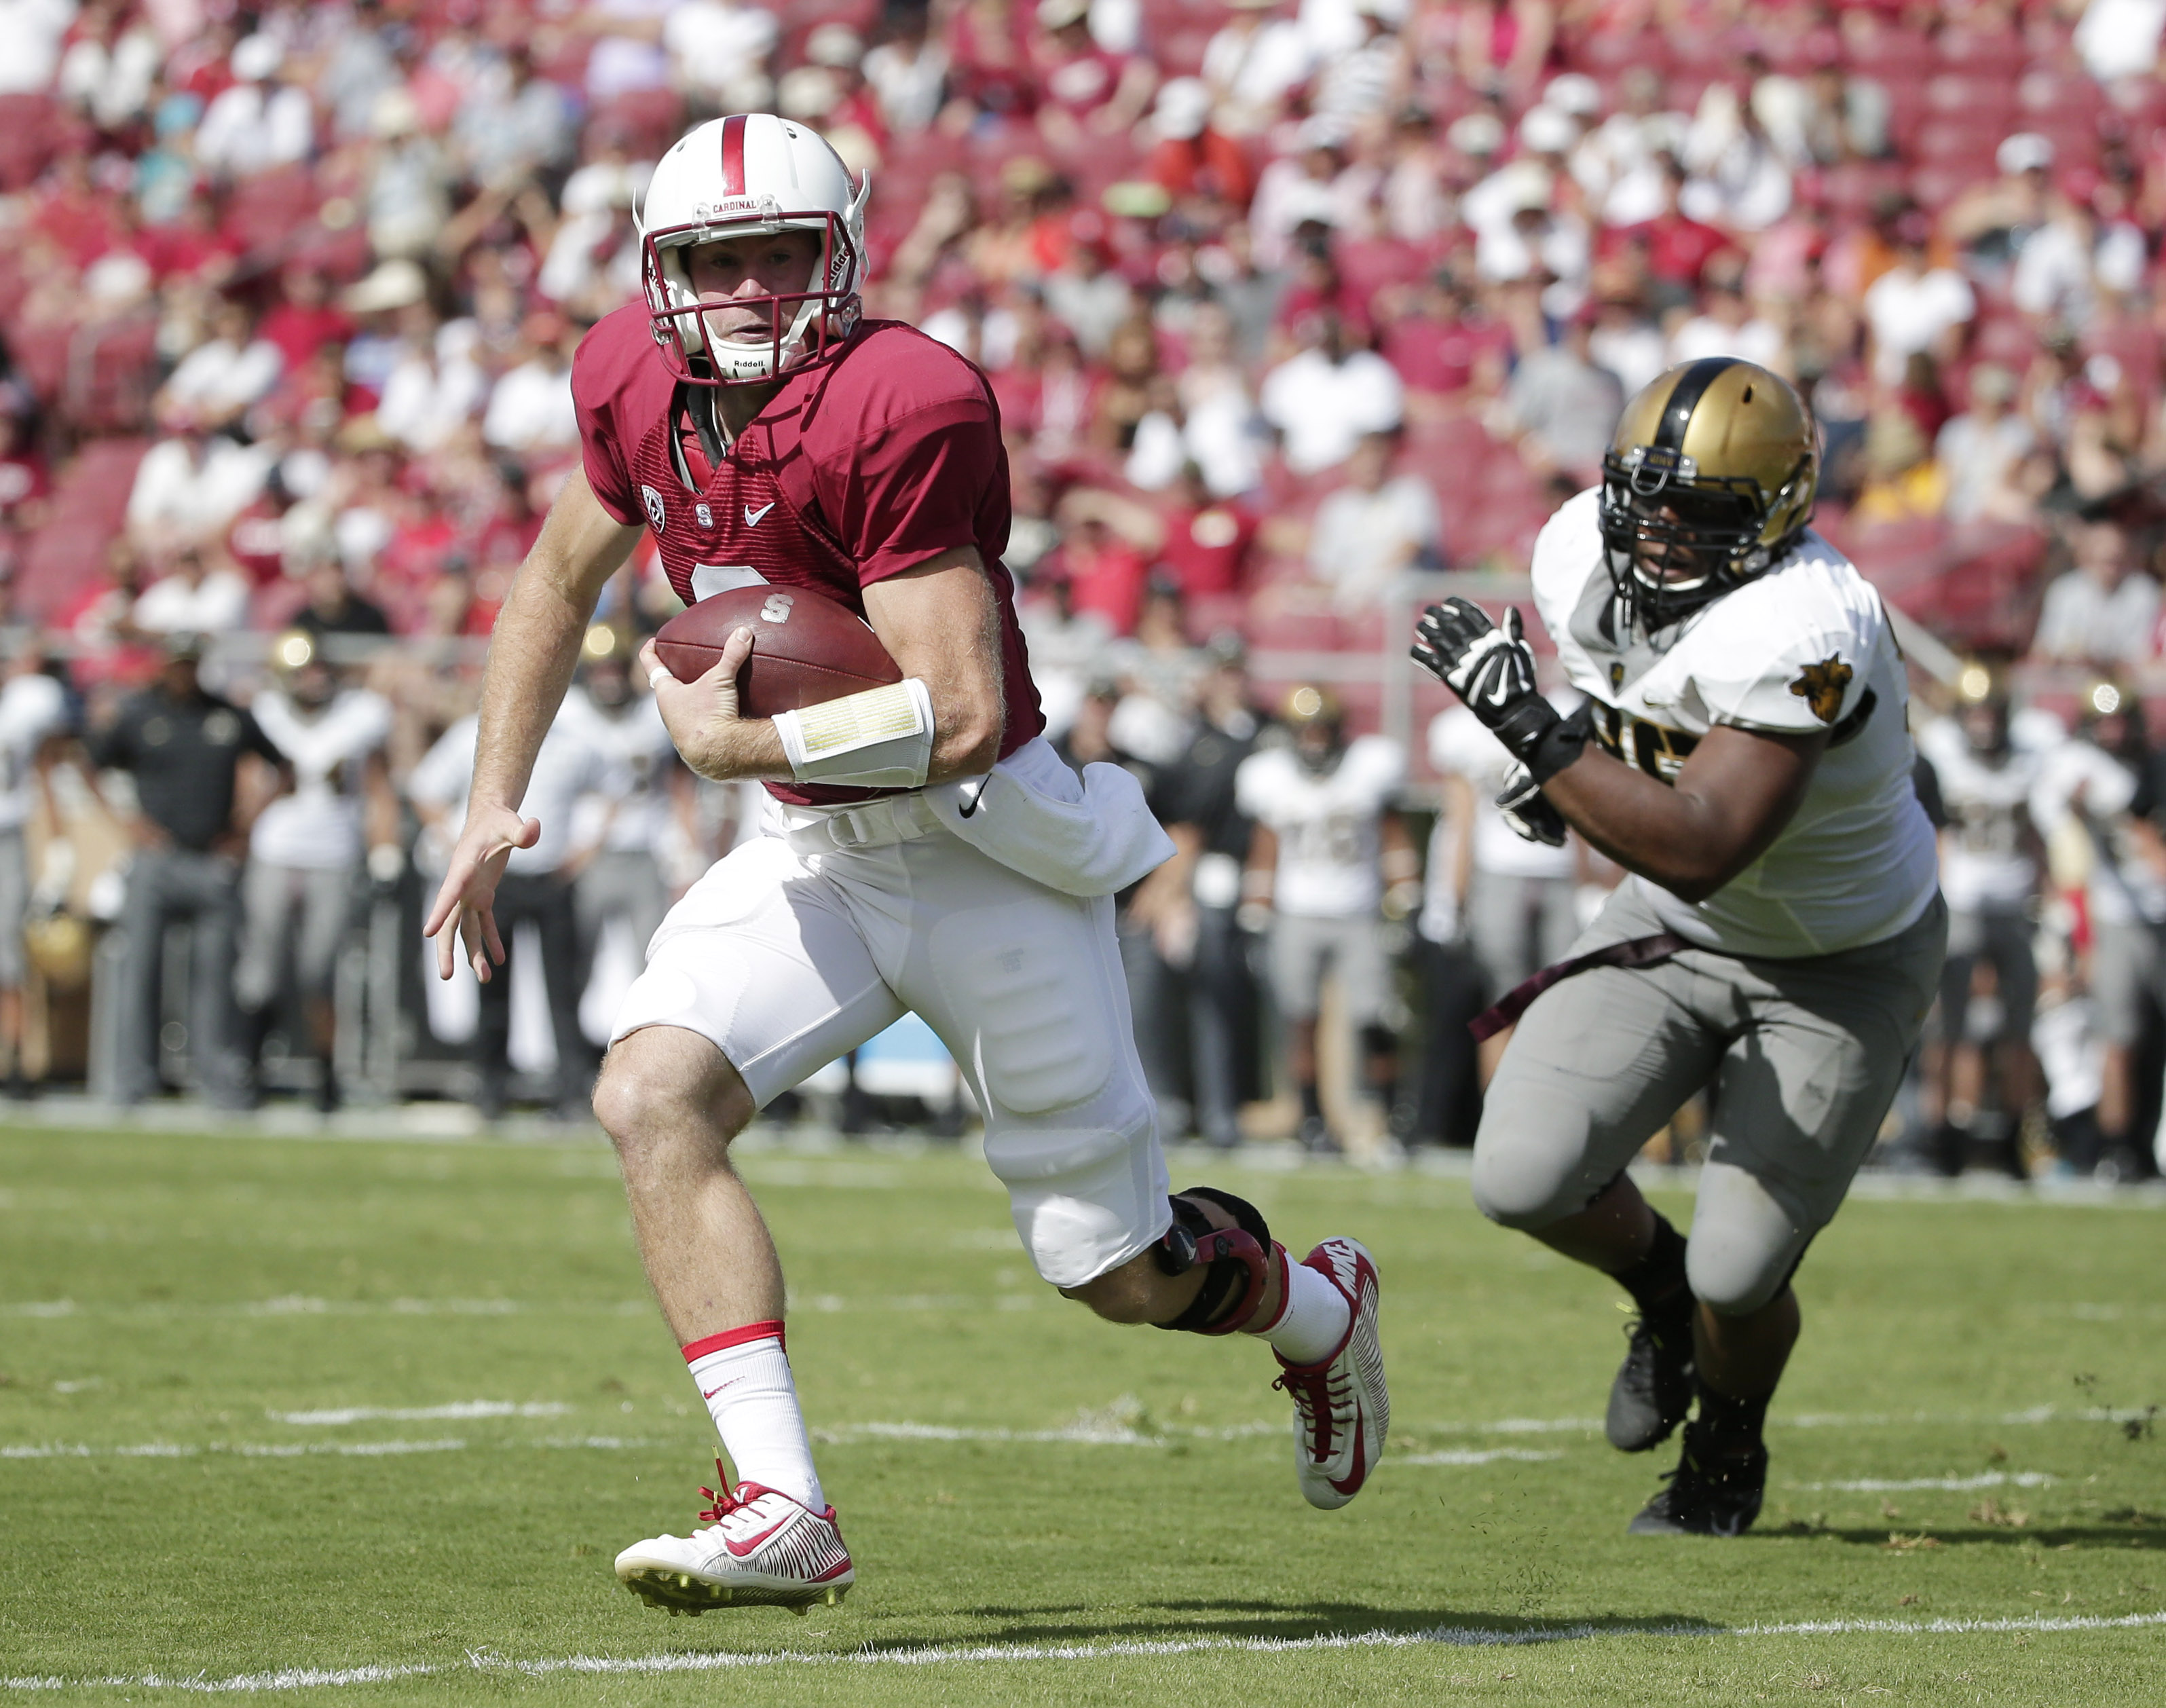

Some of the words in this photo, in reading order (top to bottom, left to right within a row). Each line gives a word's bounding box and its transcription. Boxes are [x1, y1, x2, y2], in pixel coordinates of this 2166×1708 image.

[713, 200, 757, 213] CARDINAL
[695, 503, 713, 529] S
[760, 593, 795, 624] S
